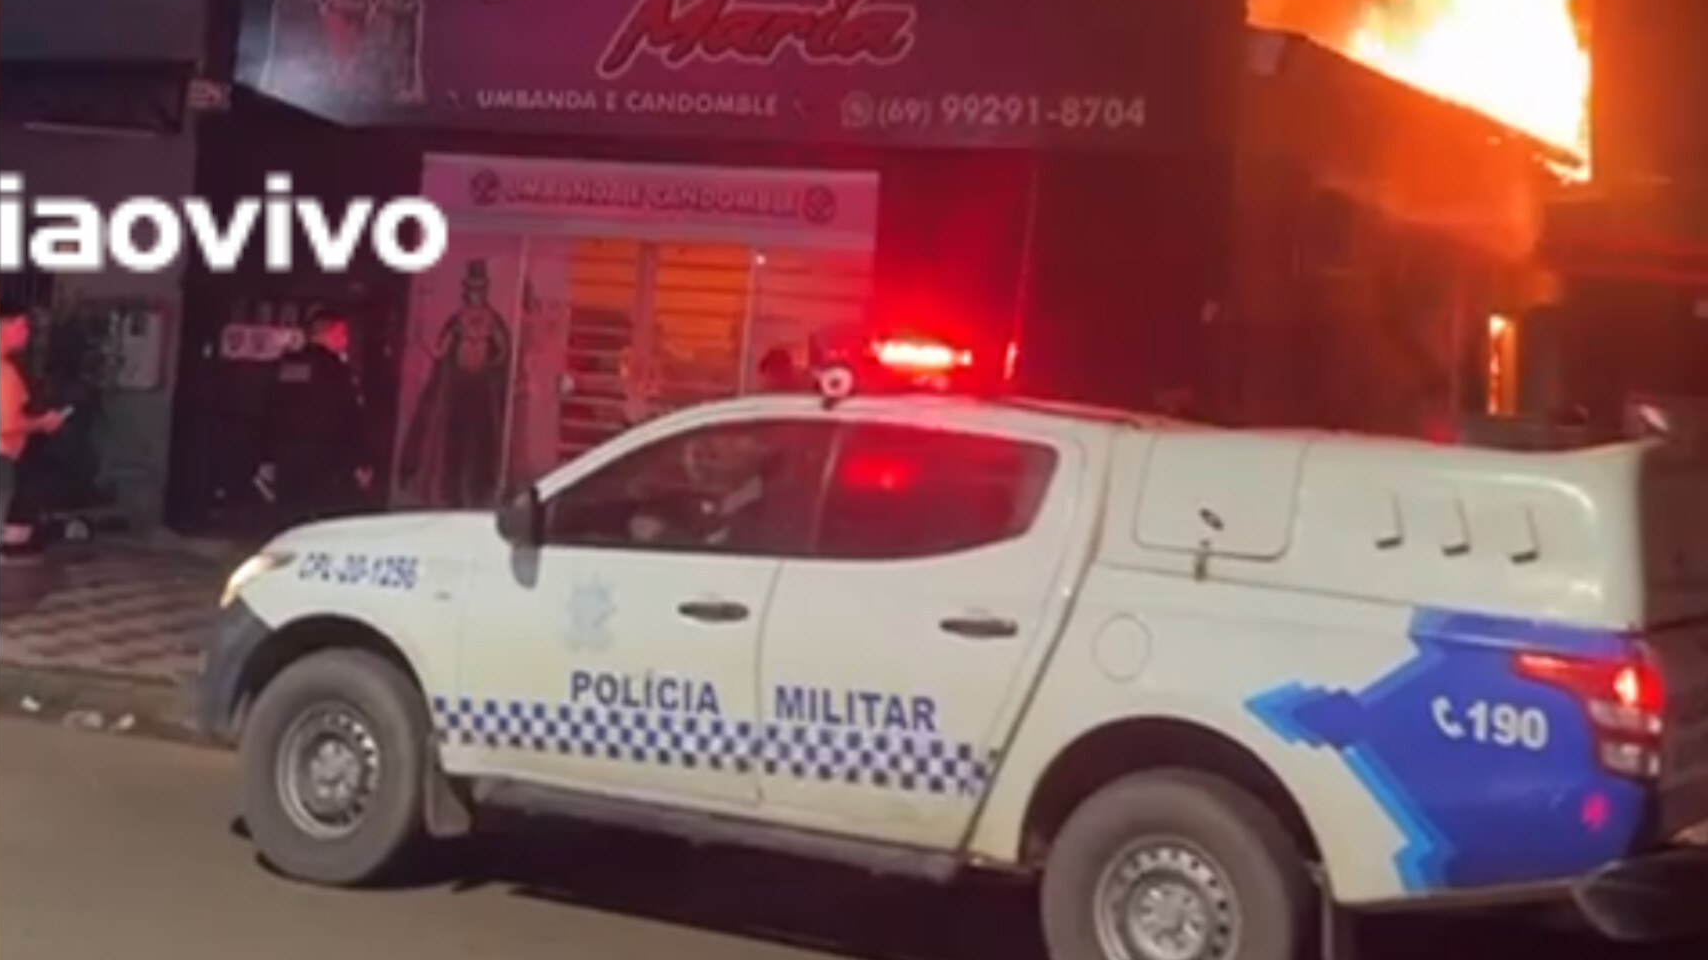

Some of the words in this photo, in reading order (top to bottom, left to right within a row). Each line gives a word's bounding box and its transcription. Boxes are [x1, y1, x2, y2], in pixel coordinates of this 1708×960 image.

[476, 89, 597, 111] UMBANDA
[605, 91, 617, 112] E
[876, 98, 932, 130] (69)
[940, 93, 1145, 128] 99291-8704
[571, 666, 720, 715] POLÍCIA
[775, 685, 936, 732] MILITAR
[1466, 699, 1549, 751] 190
